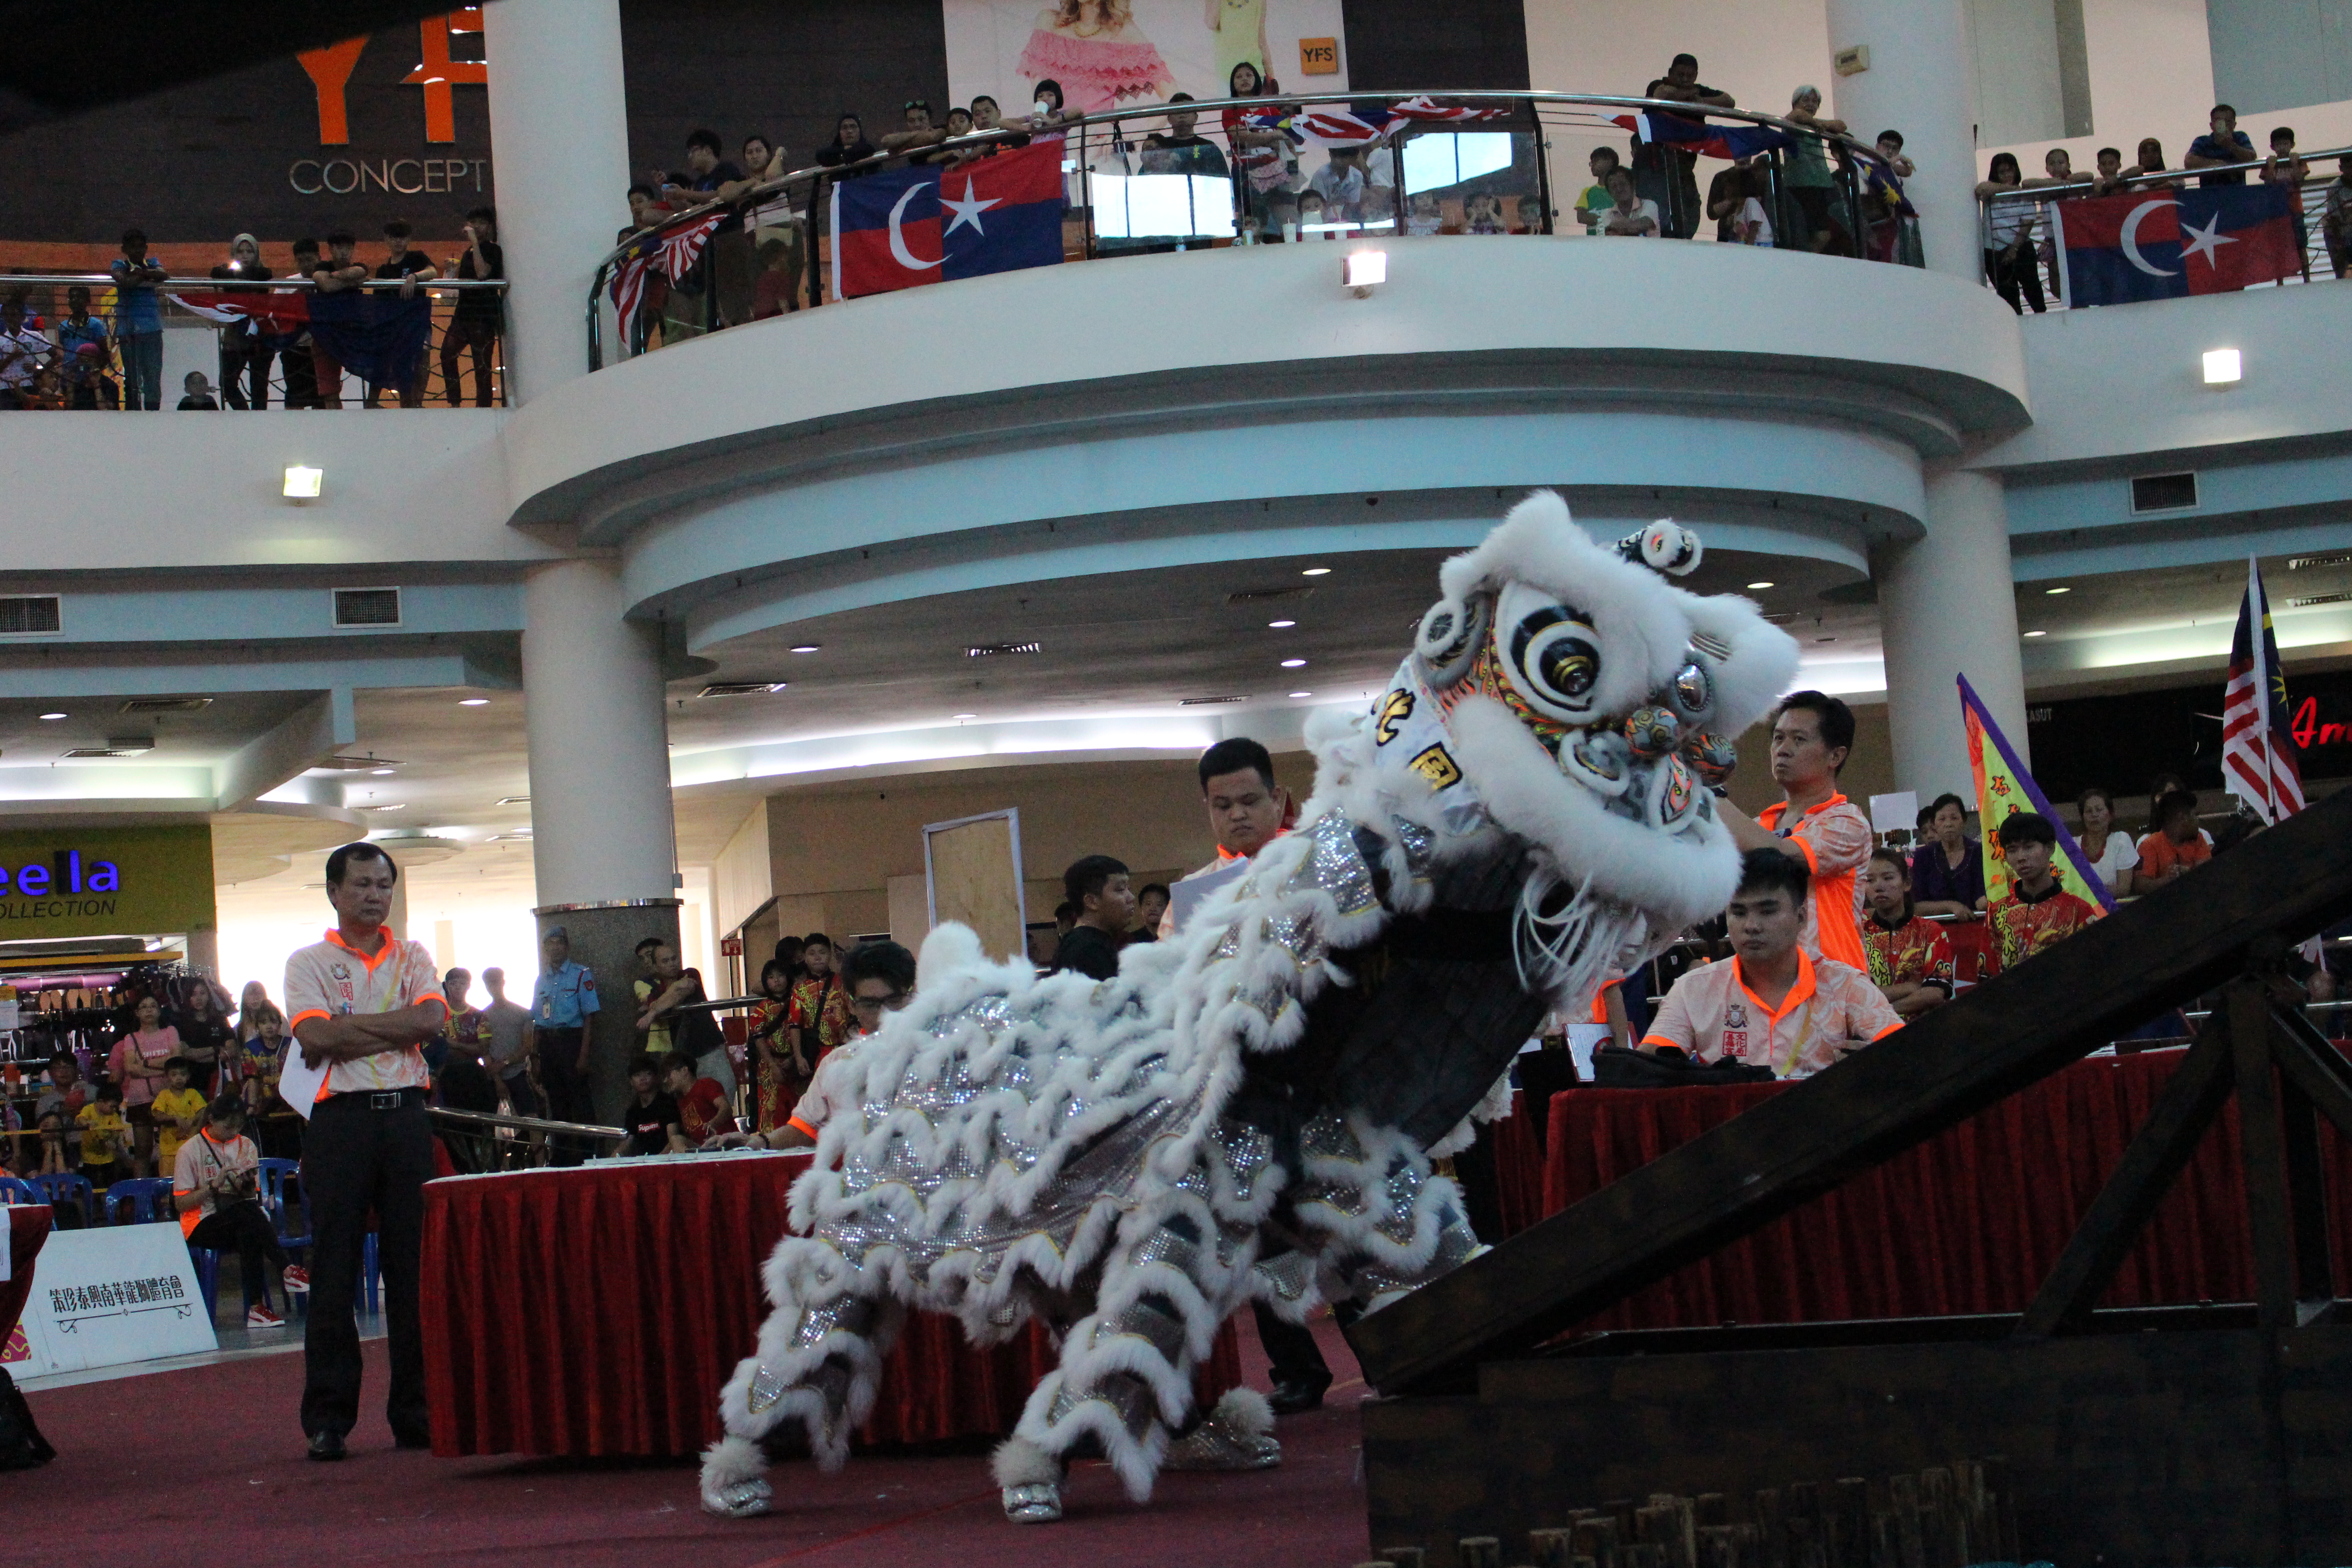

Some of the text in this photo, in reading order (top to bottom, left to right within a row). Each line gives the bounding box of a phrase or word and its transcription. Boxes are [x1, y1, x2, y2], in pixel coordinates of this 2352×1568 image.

[1303, 47, 1333, 62] YFS
[289, 159, 487, 194] CONCEPT
[2026, 708, 2052, 722] ASUT
[0, 850, 118, 896] ella
